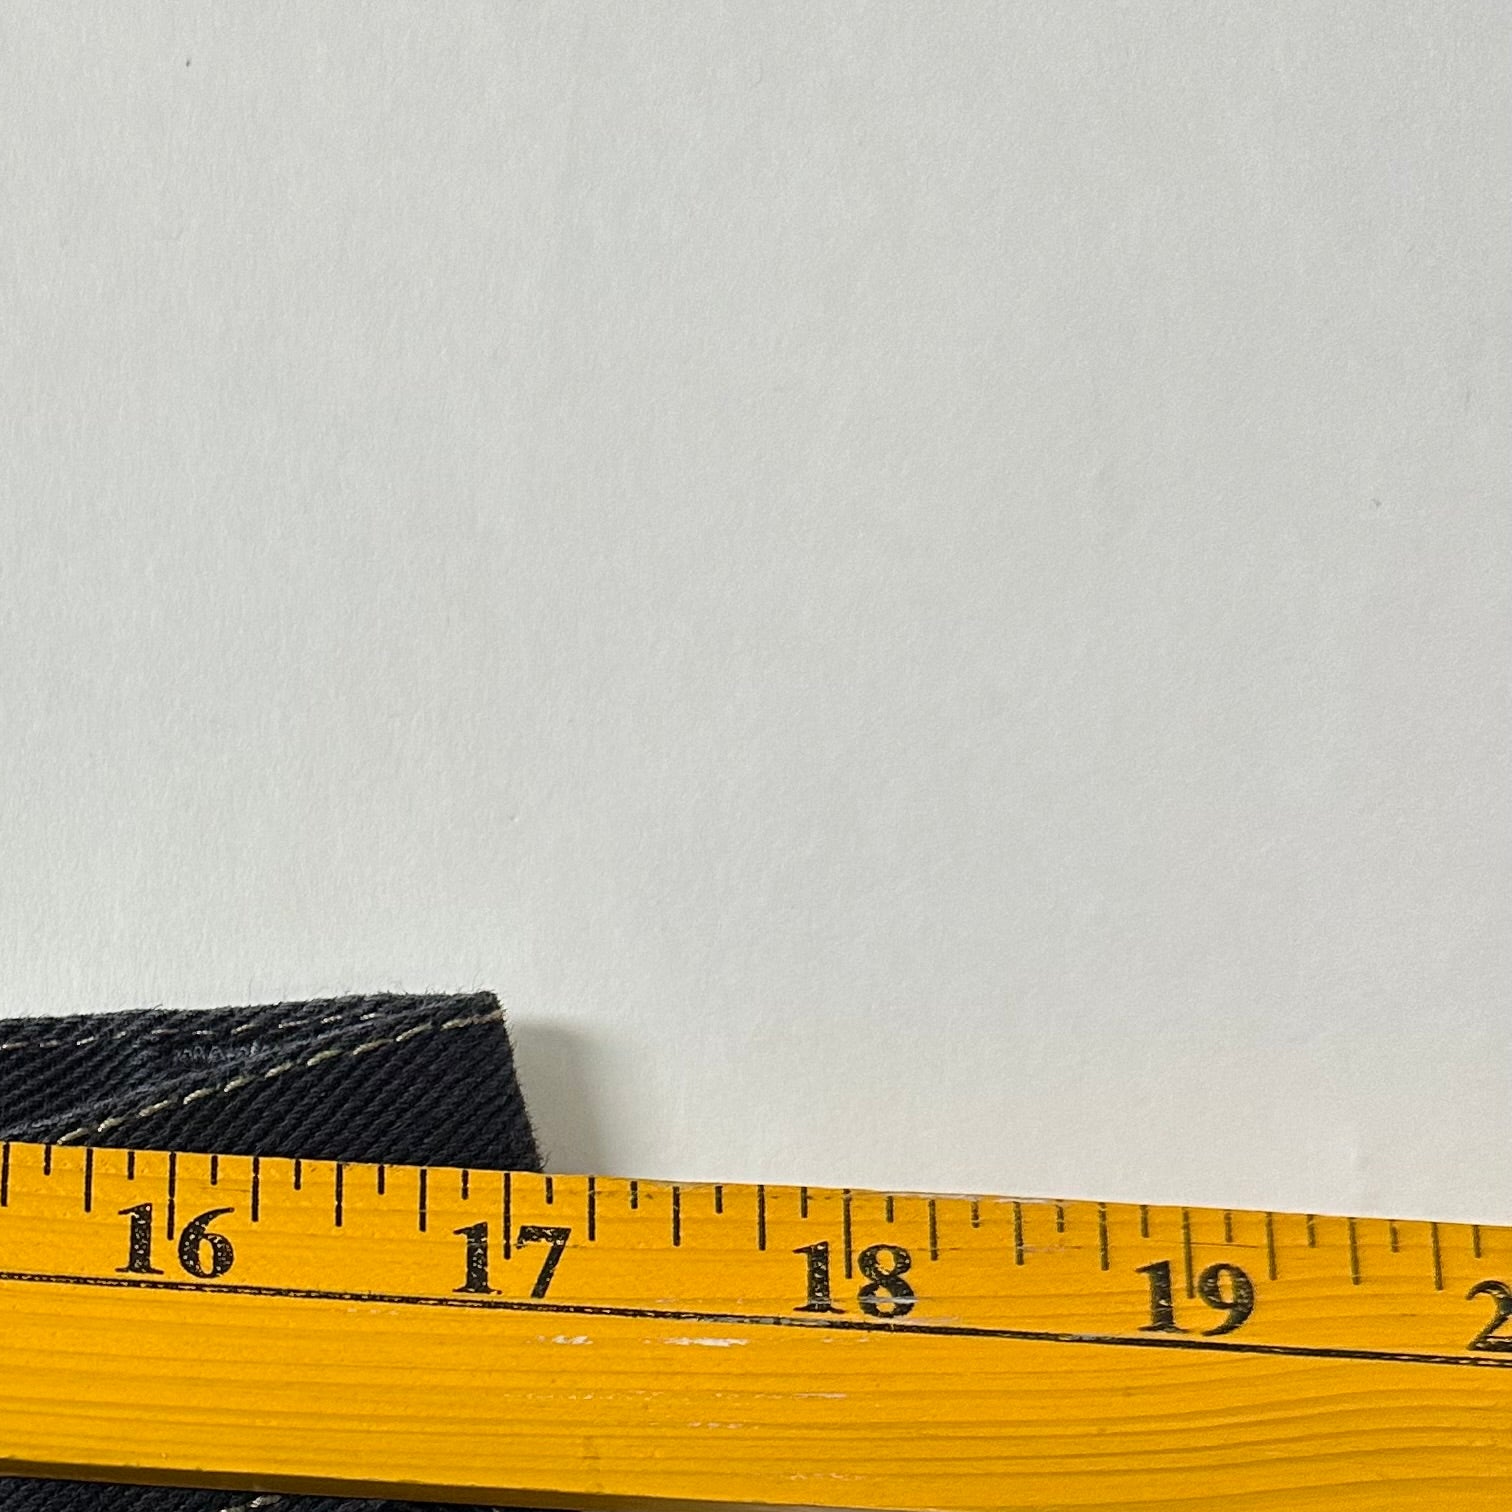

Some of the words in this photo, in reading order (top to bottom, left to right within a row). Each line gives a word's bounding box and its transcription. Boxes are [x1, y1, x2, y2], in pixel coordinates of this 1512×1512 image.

[115, 1201, 236, 1279] 16
[451, 1220, 572, 1299] 17
[790, 1239, 916, 1319] 18
[1131, 1260, 1256, 1338] 19
